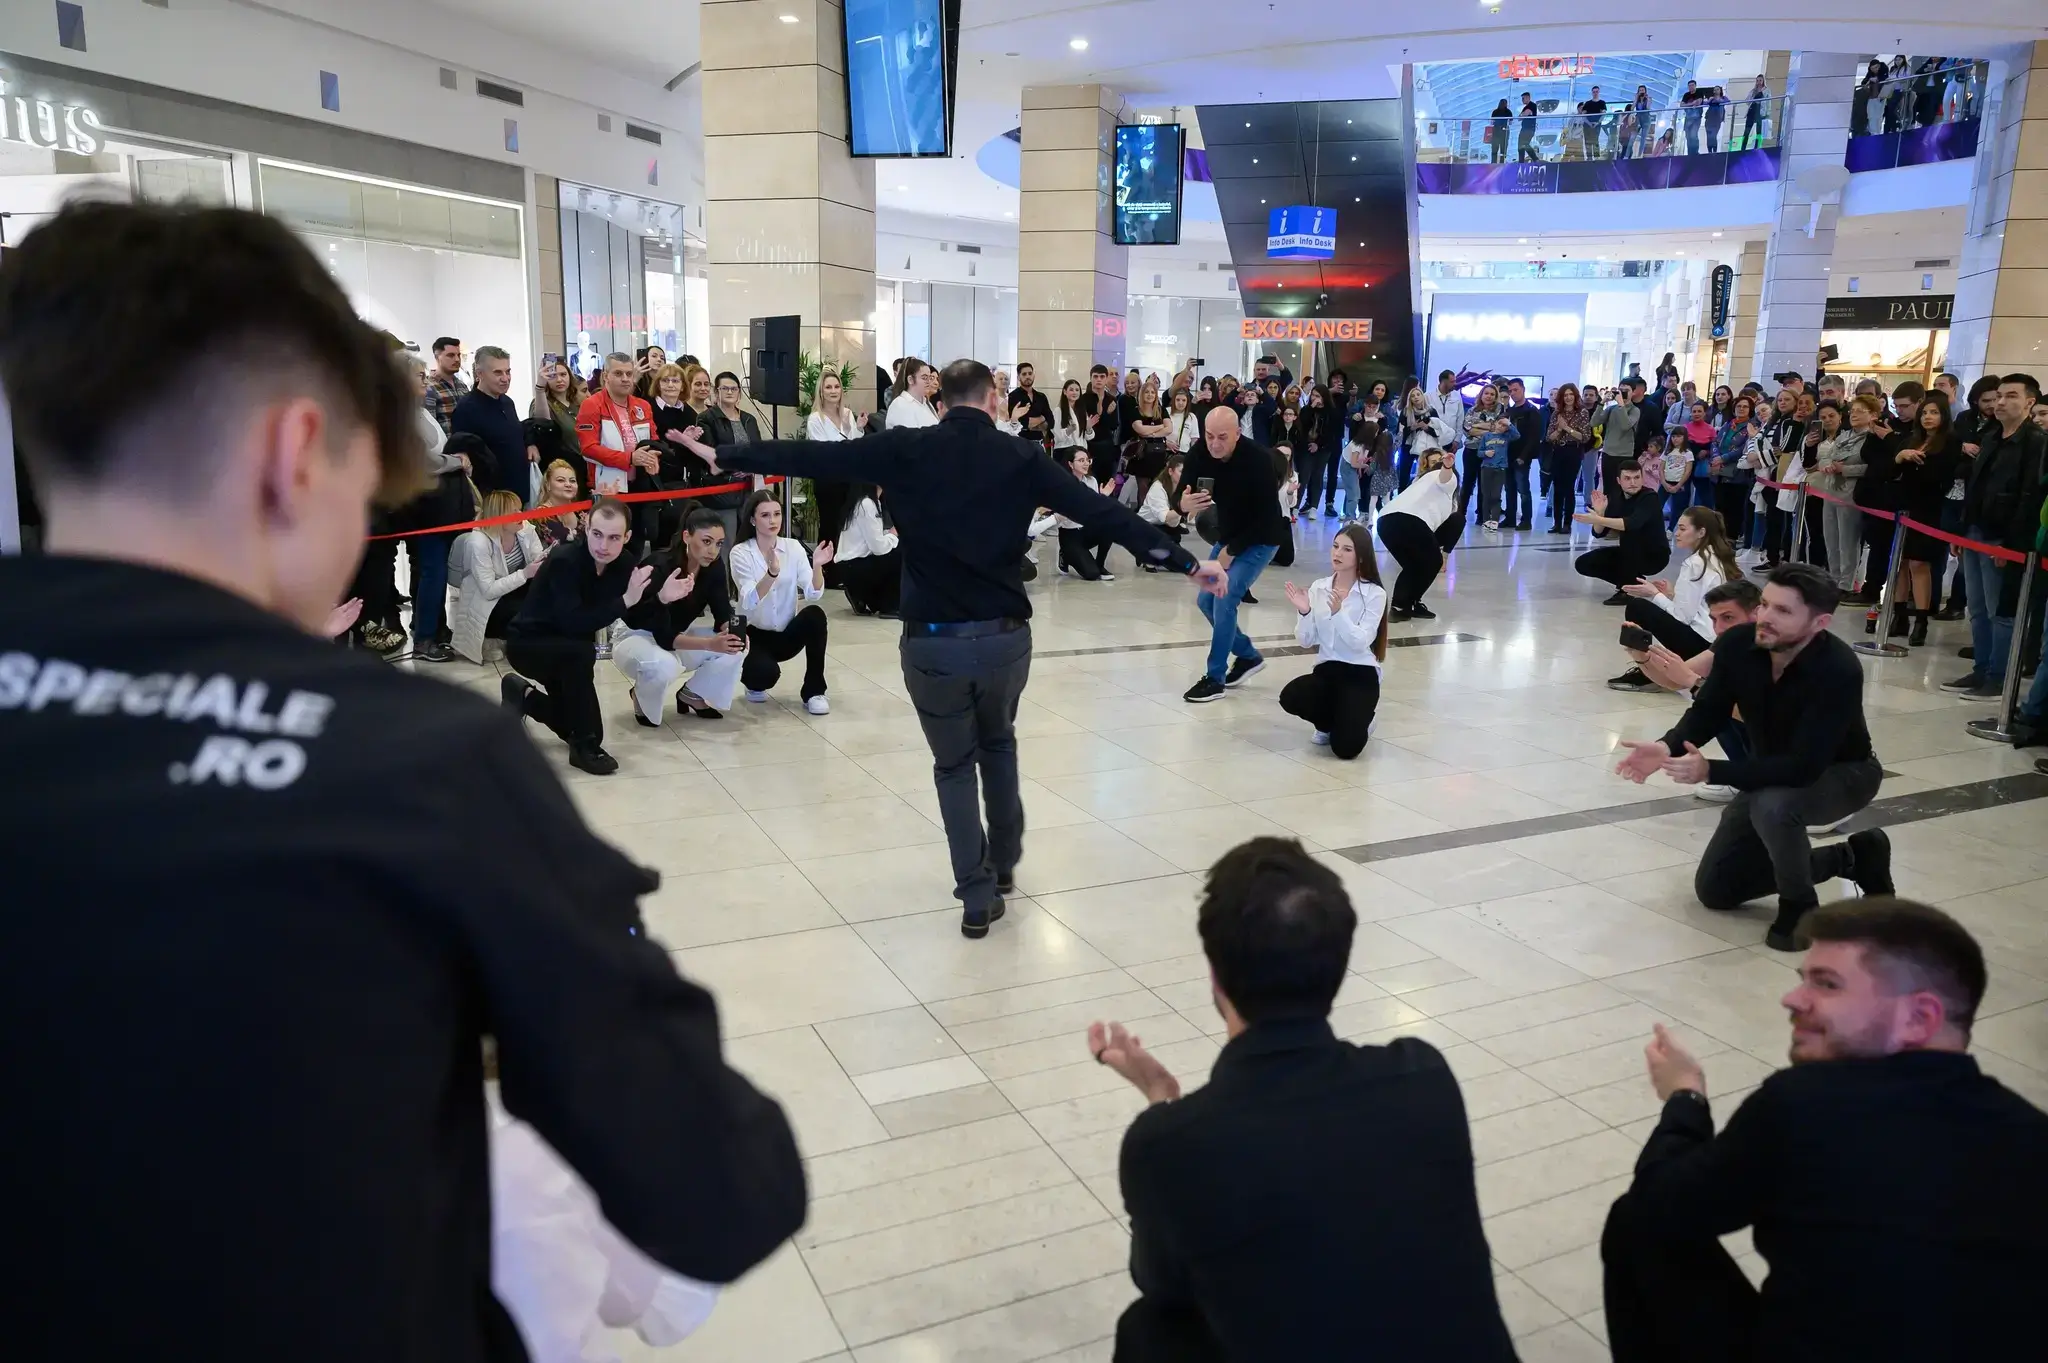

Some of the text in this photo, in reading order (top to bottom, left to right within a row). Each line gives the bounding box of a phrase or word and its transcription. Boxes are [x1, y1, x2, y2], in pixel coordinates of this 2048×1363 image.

[1498, 55, 1595, 78] DERTOUR
[1281, 237, 1296, 246] Desk
[1299, 236, 1333, 247] Info Desk
[1241, 319, 1370, 340] EXCHANGE
[0, 650, 336, 738] SPECIALE
[167, 736, 308, 790] .RO
